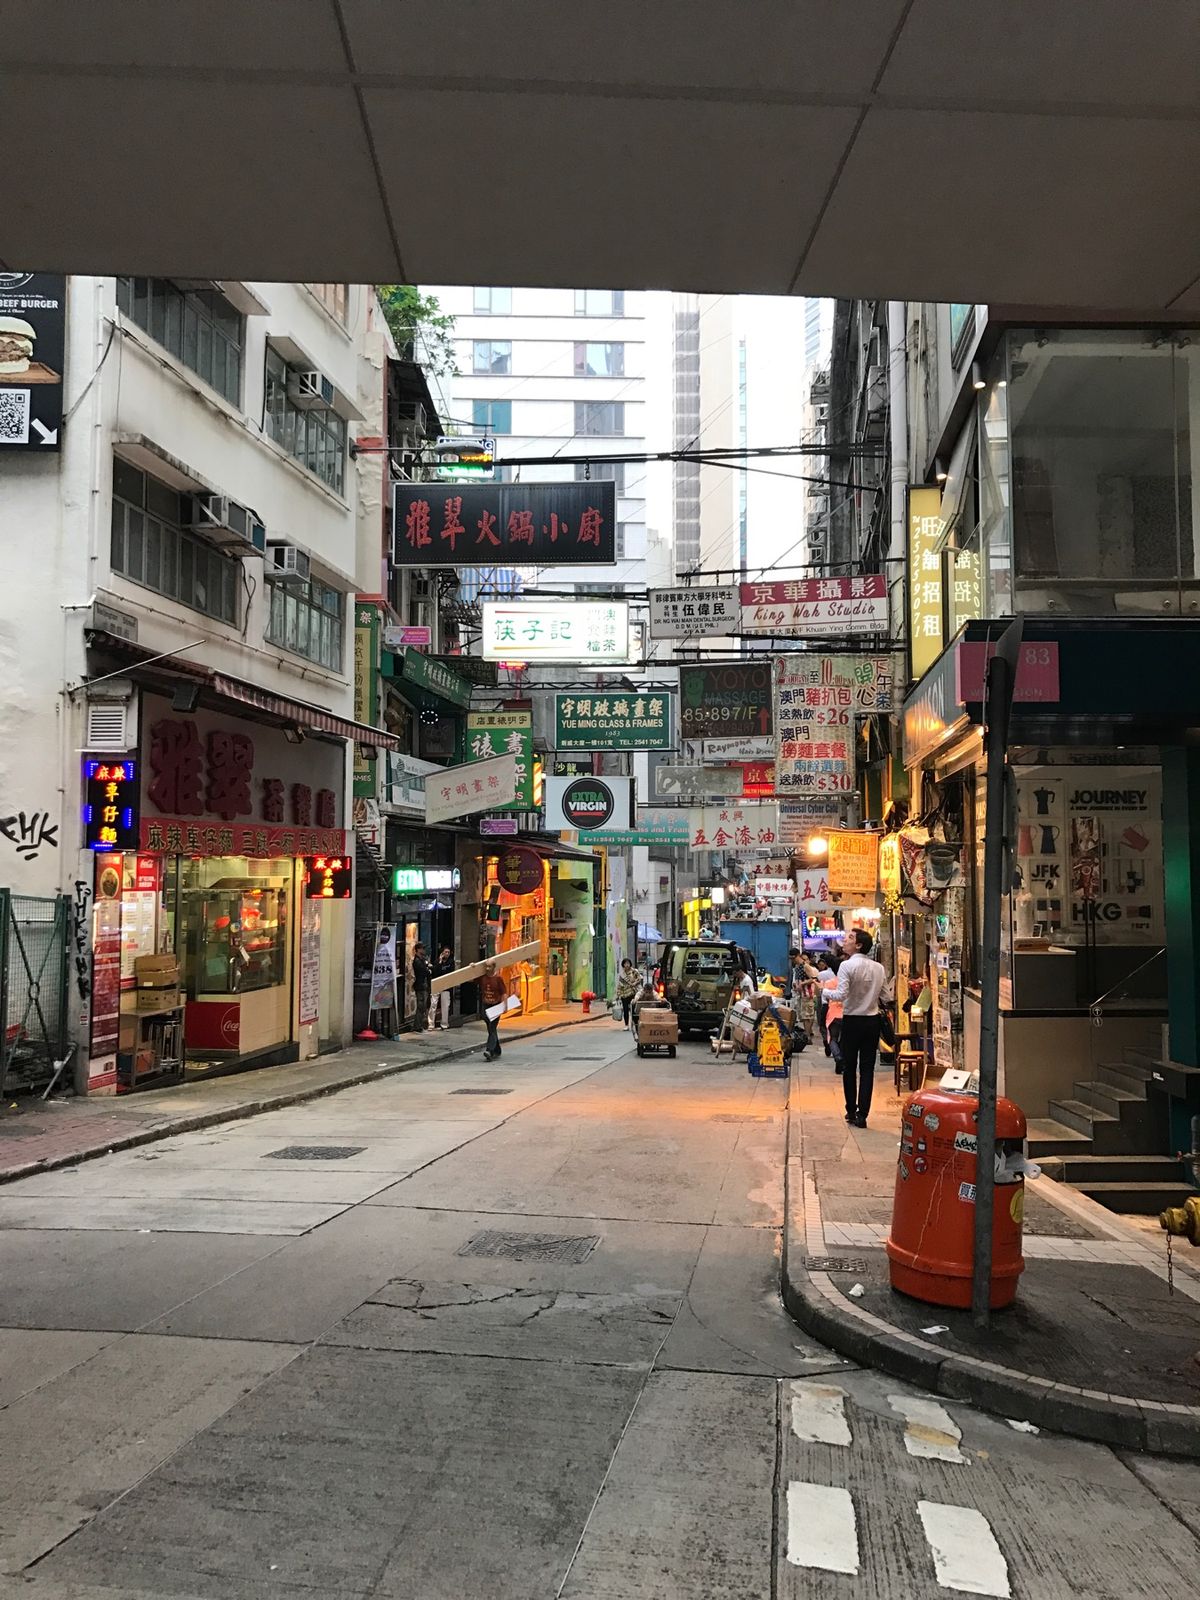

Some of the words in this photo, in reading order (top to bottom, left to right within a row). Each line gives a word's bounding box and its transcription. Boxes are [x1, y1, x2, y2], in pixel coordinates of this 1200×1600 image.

[21, 299, 59, 309] BURGER
[750, 577, 875, 603] 京華攝影
[682, 603, 725, 616] 伍偉民
[753, 606, 785, 624] King
[793, 603, 820, 618] Wah
[828, 601, 875, 616] Studio
[494, 620, 573, 641] 筷子記
[829, 624, 844, 632] Ying
[1025, 648, 1050, 665] 83
[709, 669, 767, 690] YOYO
[705, 690, 767, 705] MASSAGE
[560, 697, 664, 718] 宇明玻璃畫架
[561, 719, 577, 728] YUE
[578, 719, 597, 728] MING
[598, 719, 624, 728] GLASS
[625, 719, 631, 728] &
[632, 718, 664, 727] FRAMES
[779, 708, 815, 720] 送熱飲
[817, 708, 849, 726] $26
[780, 725, 810, 742] 澳門
[818, 773, 851, 791] $30
[571, 791, 605, 802] EXTRA
[1070, 789, 1147, 804] JOURNEY
[568, 801, 607, 811] VIRGIN
[780, 804, 807, 813] Universal
[808, 803, 824, 814] Cyber
[691, 825, 776, 847] 五金漆油
[1031, 865, 1060, 878] JFK
[1072, 903, 1122, 921] HKG
